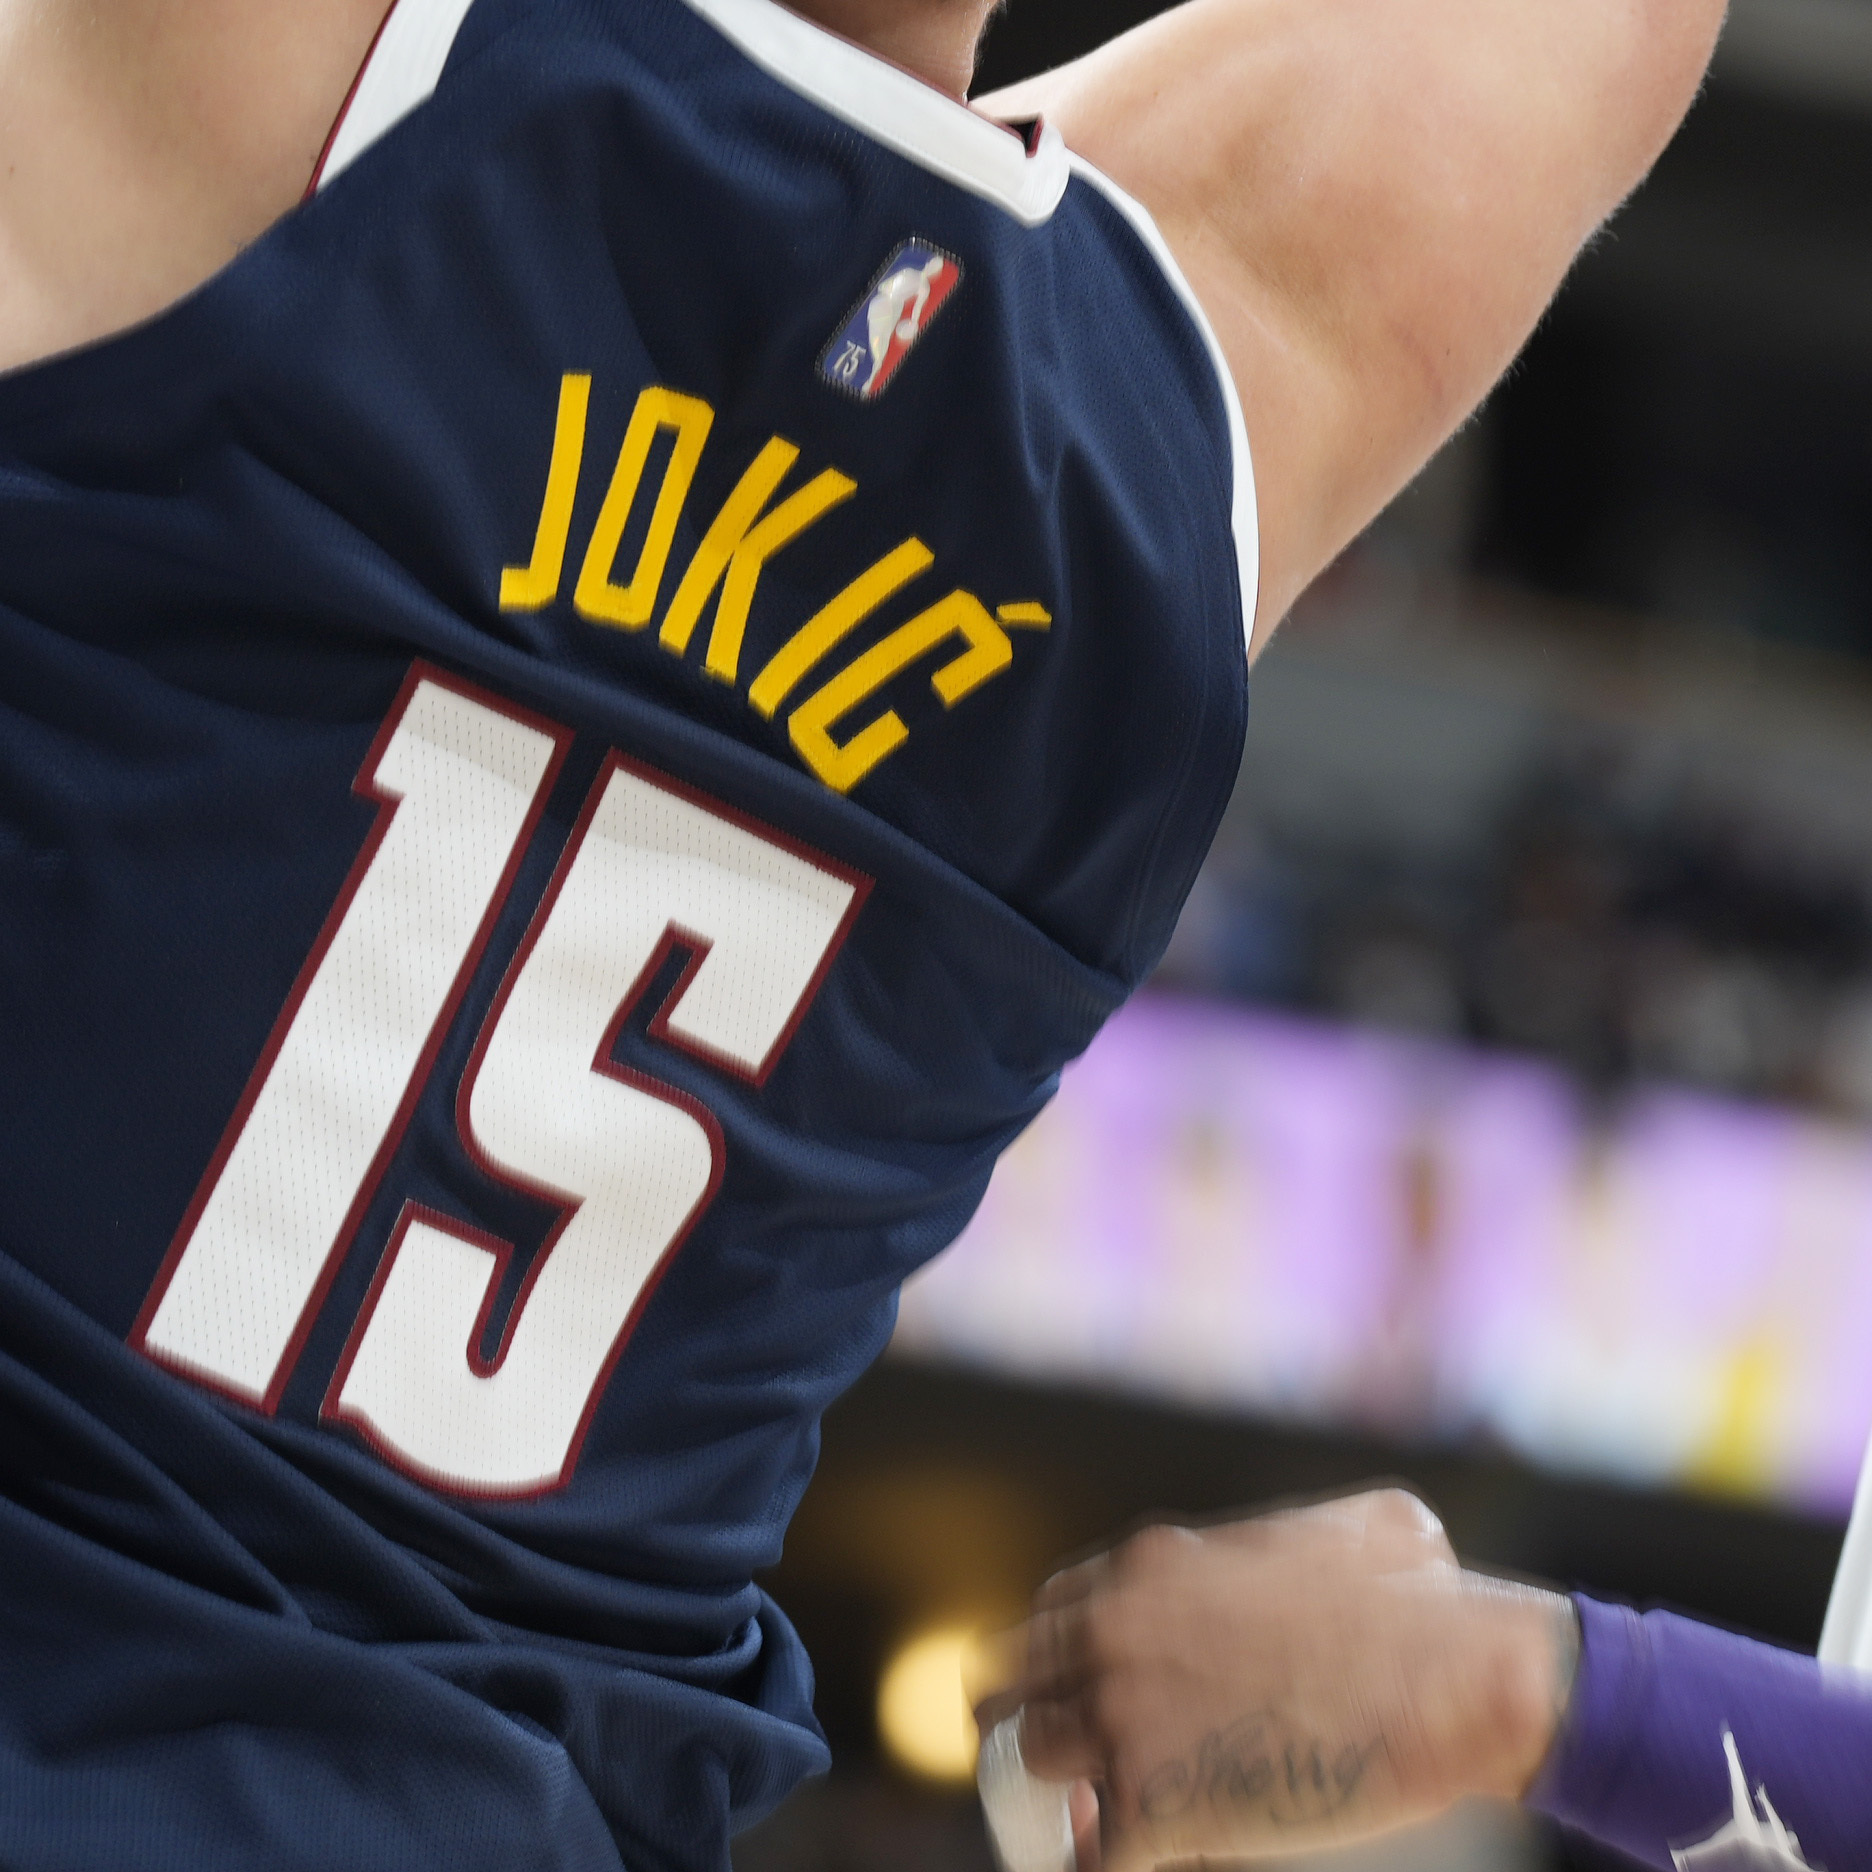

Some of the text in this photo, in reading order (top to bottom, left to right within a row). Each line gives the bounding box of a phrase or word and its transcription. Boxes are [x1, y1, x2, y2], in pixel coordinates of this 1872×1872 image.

[833, 339, 867, 379] 75
[498, 369, 1052, 794] JOKIĆ
[128, 657, 876, 1504] 15
